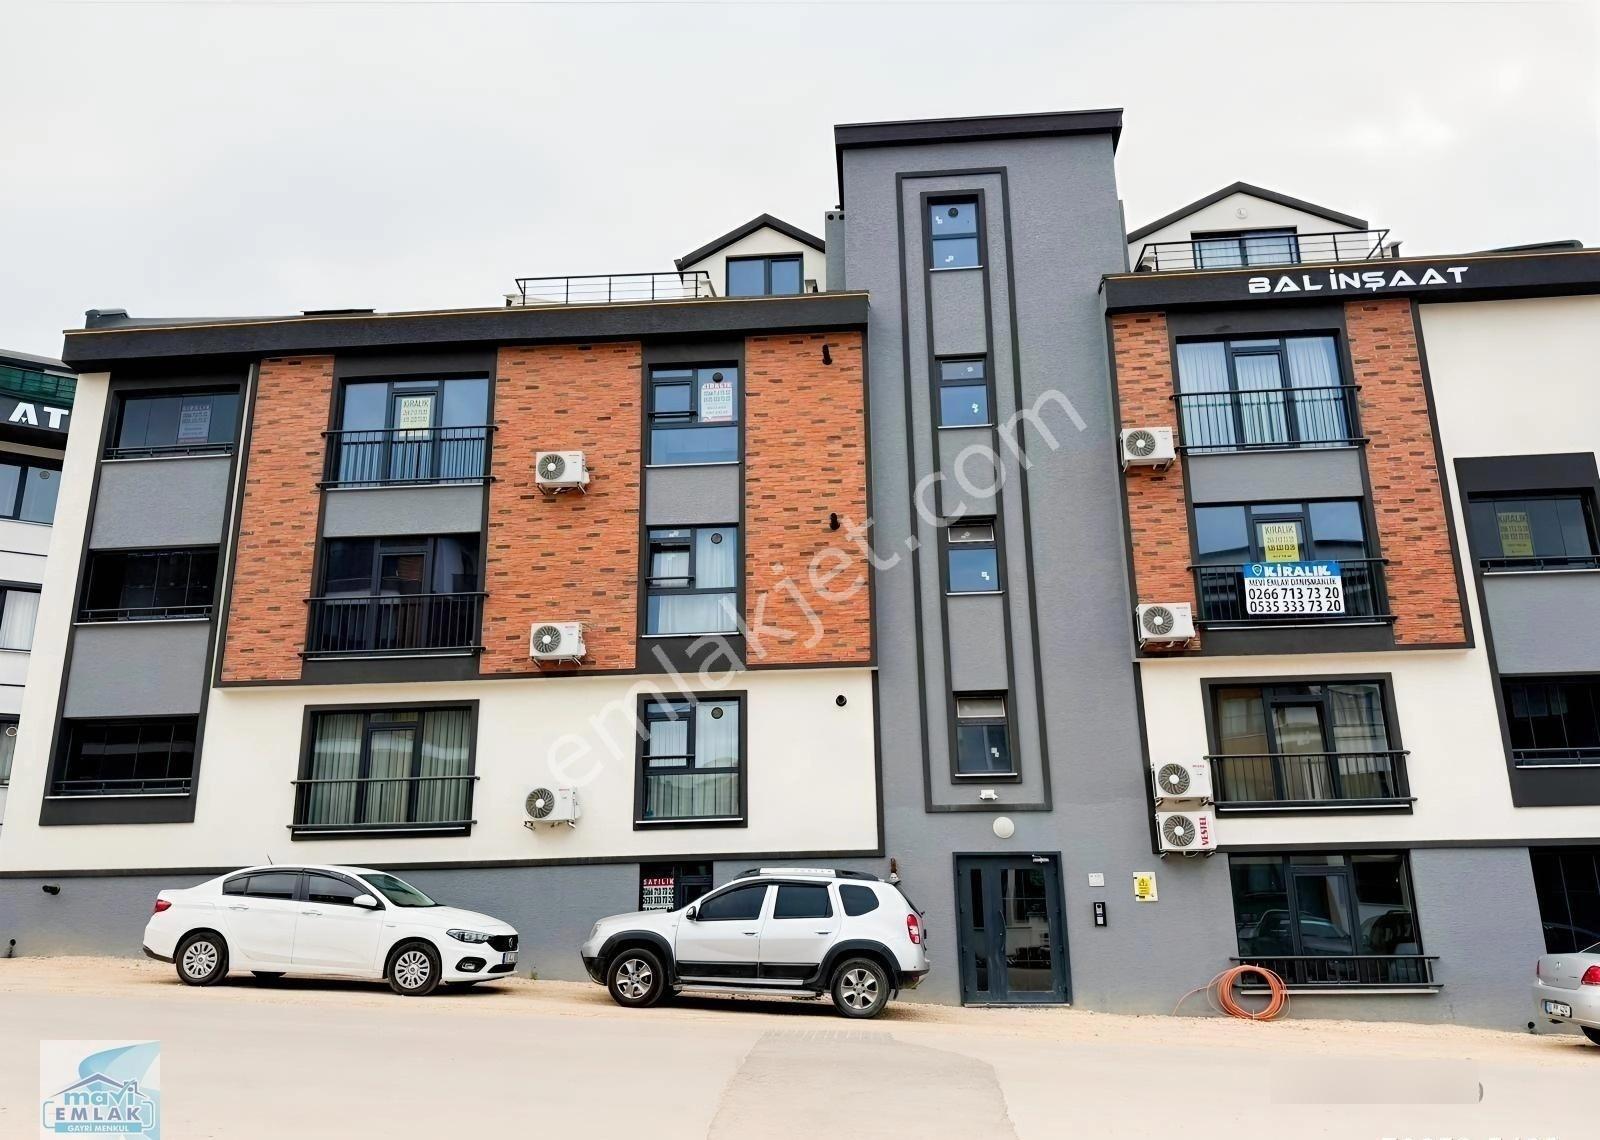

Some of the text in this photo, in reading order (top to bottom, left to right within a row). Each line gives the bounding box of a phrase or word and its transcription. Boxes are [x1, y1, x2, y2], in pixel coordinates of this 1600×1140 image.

[1248, 266, 1468, 294] BAL İNŞAAT
[1264, 564, 1331, 577] KİRALIK
[1248, 586, 1340, 600] 0266 713 73 20
[1250, 599, 1341, 613] 0535 333 73 20
